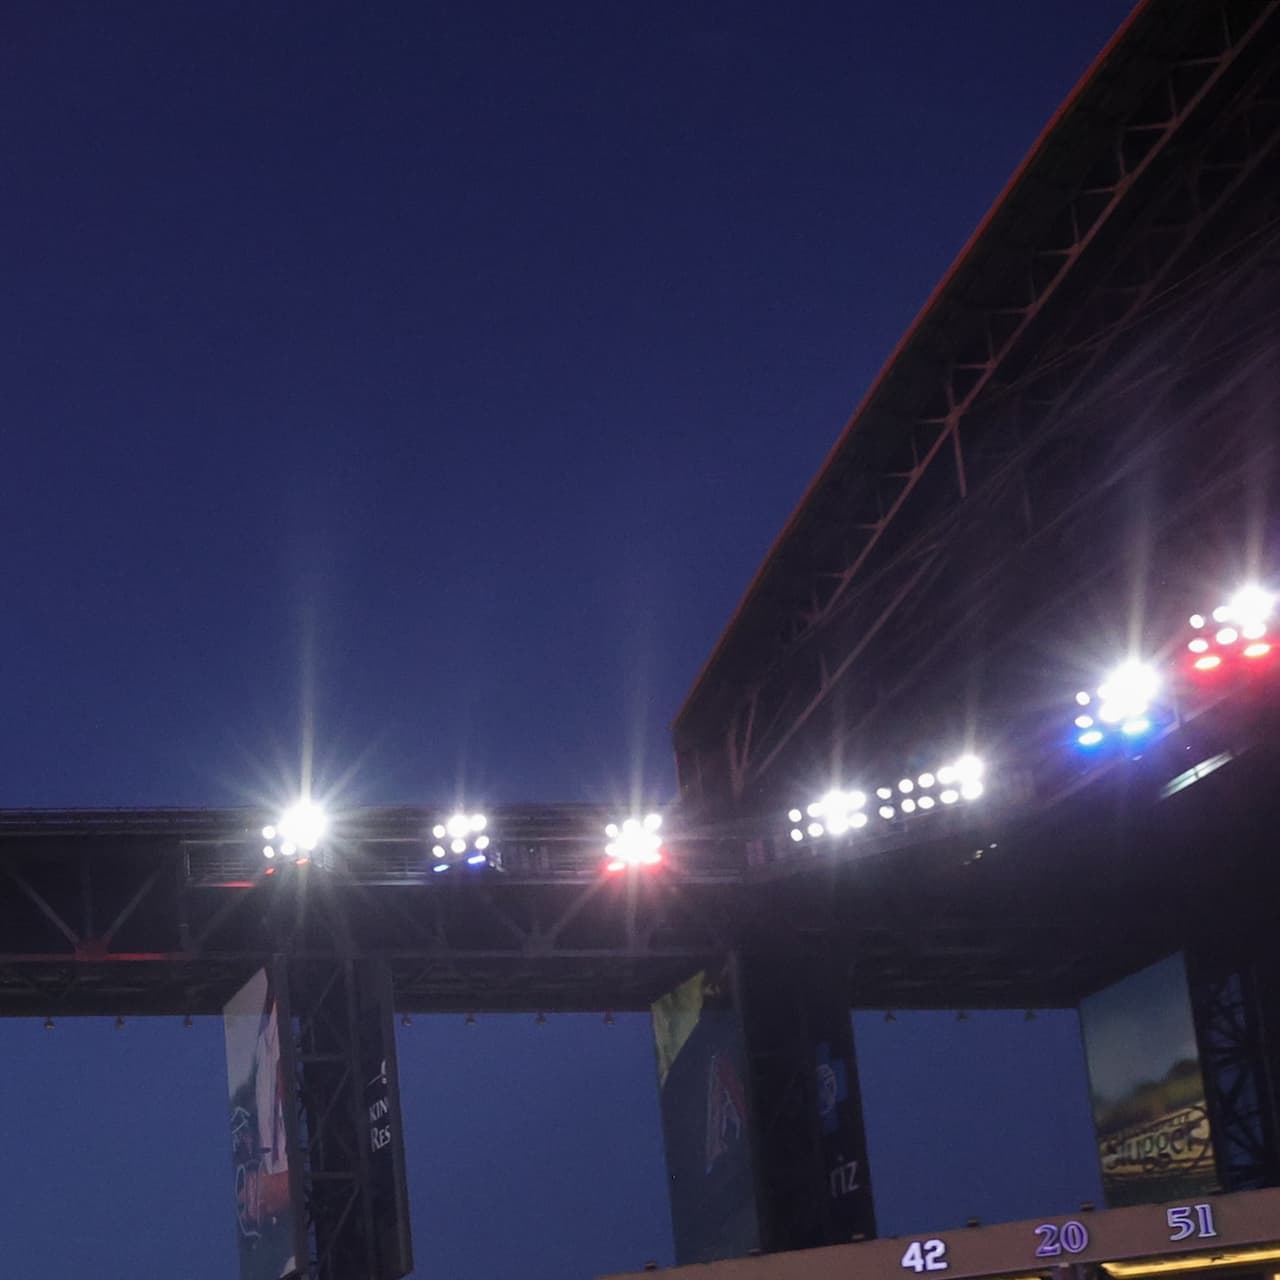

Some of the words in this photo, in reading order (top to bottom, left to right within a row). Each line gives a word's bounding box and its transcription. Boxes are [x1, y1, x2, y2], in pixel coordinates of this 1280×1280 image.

[1034, 1221, 1088, 1256] 20
[1167, 1204, 1216, 1241] 51
[901, 1240, 948, 1272] 42
